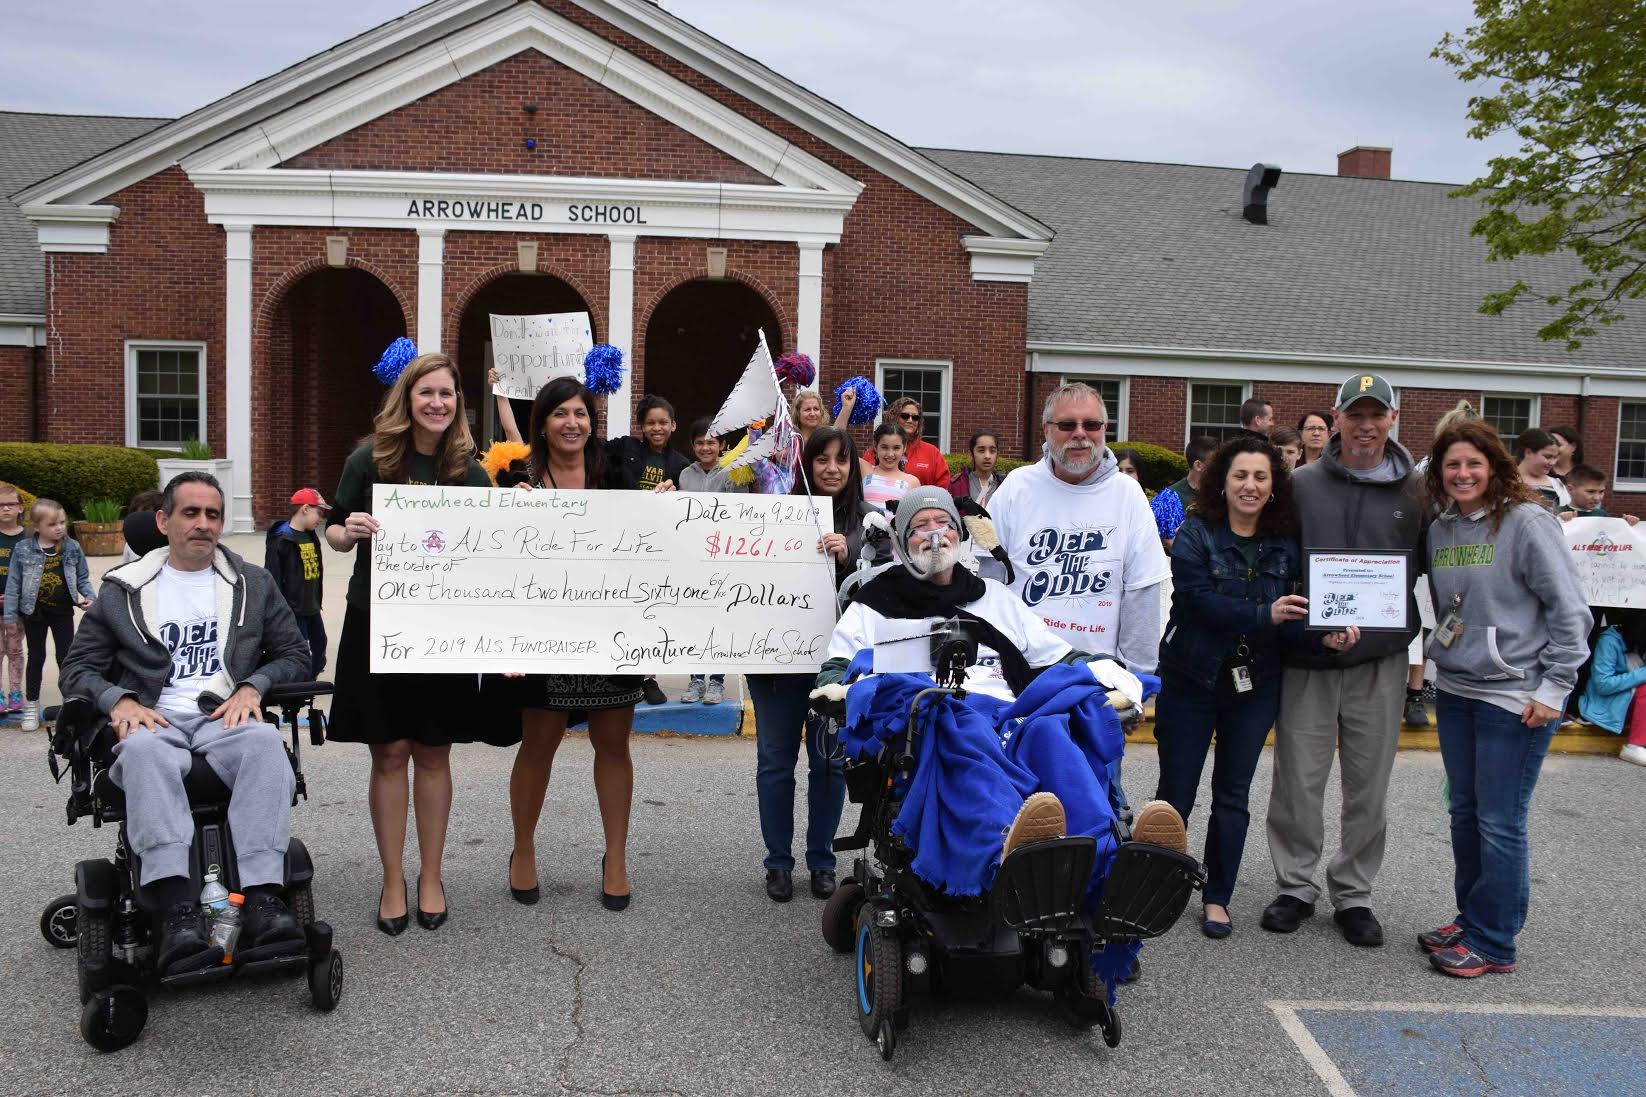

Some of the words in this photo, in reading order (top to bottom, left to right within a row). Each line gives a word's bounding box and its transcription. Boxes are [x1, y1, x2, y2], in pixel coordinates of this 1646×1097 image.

[407, 199, 543, 221] ARROWHEAD
[568, 205, 647, 224] SCHOOL
[491, 316, 527, 340] Don't
[1360, 376, 1374, 393] P
[384, 487, 491, 511] Arrowhead
[498, 489, 588, 519] Elementary
[675, 496, 732, 531] Date
[735, 501, 766, 536] May
[373, 529, 395, 557] Pay
[397, 532, 418, 553] to
[451, 526, 506, 552] ALS
[512, 525, 565, 560] Ride
[569, 529, 603, 553] For
[1027, 526, 1118, 565] DEFY
[1431, 543, 1496, 569] ARROWHEAD
[375, 554, 403, 572] the
[403, 552, 440, 572] order
[1054, 552, 1091, 575] THE
[426, 569, 518, 601] thousand
[522, 574, 558, 601] two
[562, 569, 638, 602] hundred
[683, 584, 710, 600] one
[726, 582, 814, 612] Dollars
[1022, 569, 1114, 607] ODDS
[1043, 617, 1067, 630] Ride
[1070, 622, 1088, 632] For
[1089, 624, 1106, 633] Life
[180, 645, 217, 665] THE
[380, 632, 414, 660] For
[423, 636, 467, 656] 2019
[473, 635, 503, 654] ALS
[510, 635, 600, 655] FUNDRAISER
[610, 626, 701, 673] Signature
